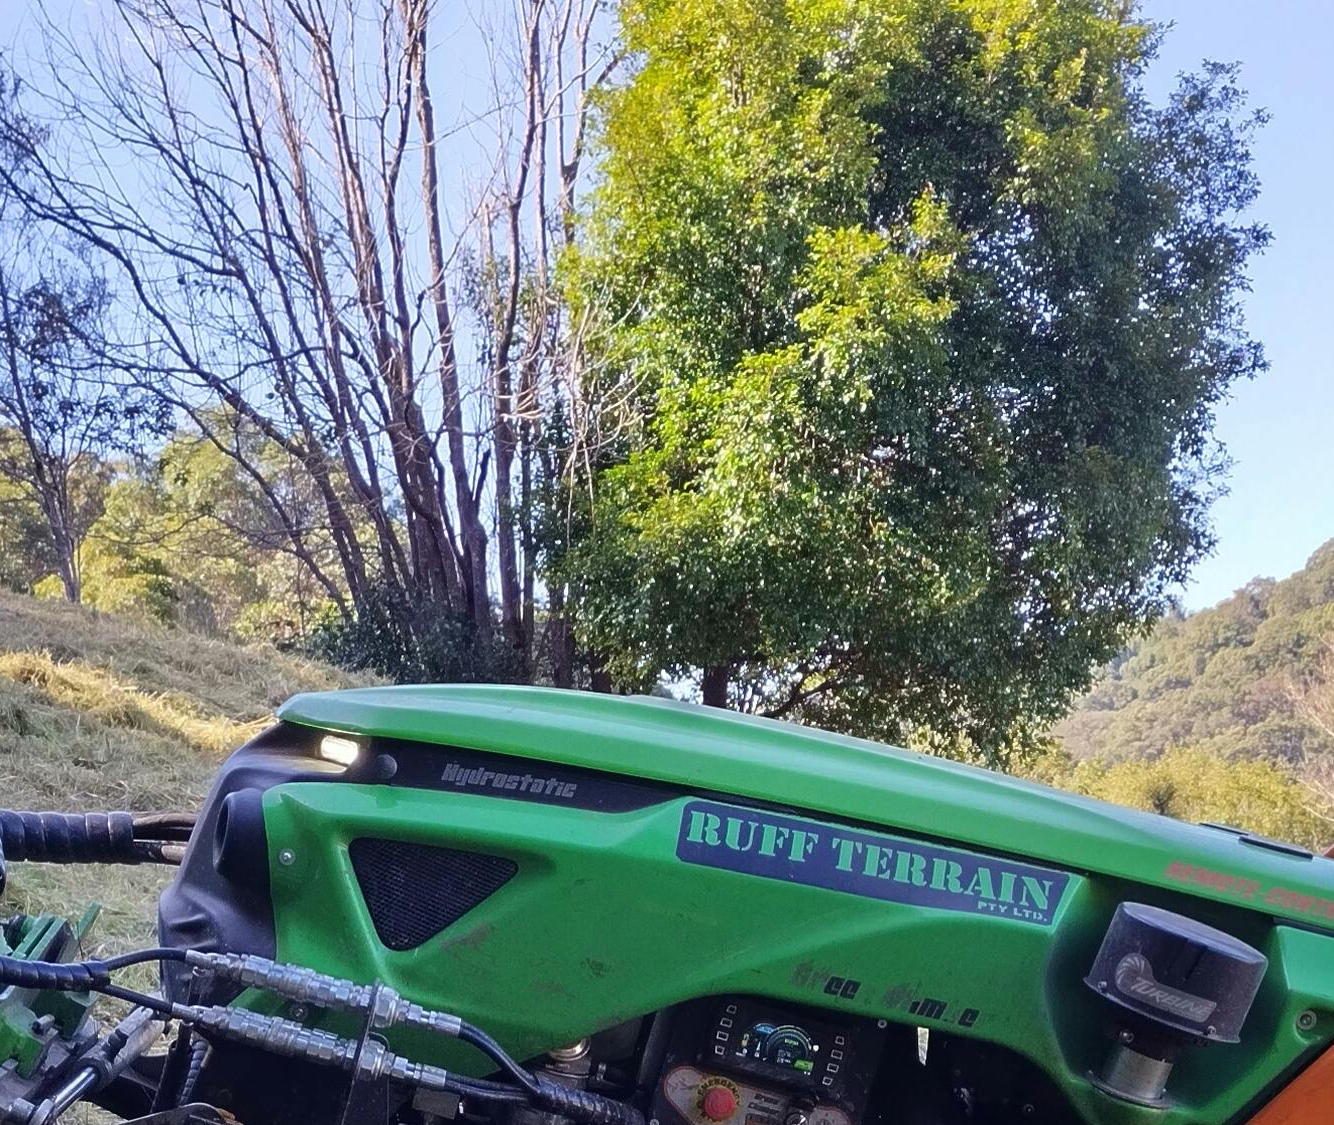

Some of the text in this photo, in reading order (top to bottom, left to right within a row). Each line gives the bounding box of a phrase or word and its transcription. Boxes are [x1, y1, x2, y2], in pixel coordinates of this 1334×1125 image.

[441, 762, 577, 798] Hydrostatic
[686, 810, 1053, 911] RUFF TERRAIN
[977, 900, 1048, 923] PTY LTD.
[1131, 977, 1213, 1020] TURBINE
